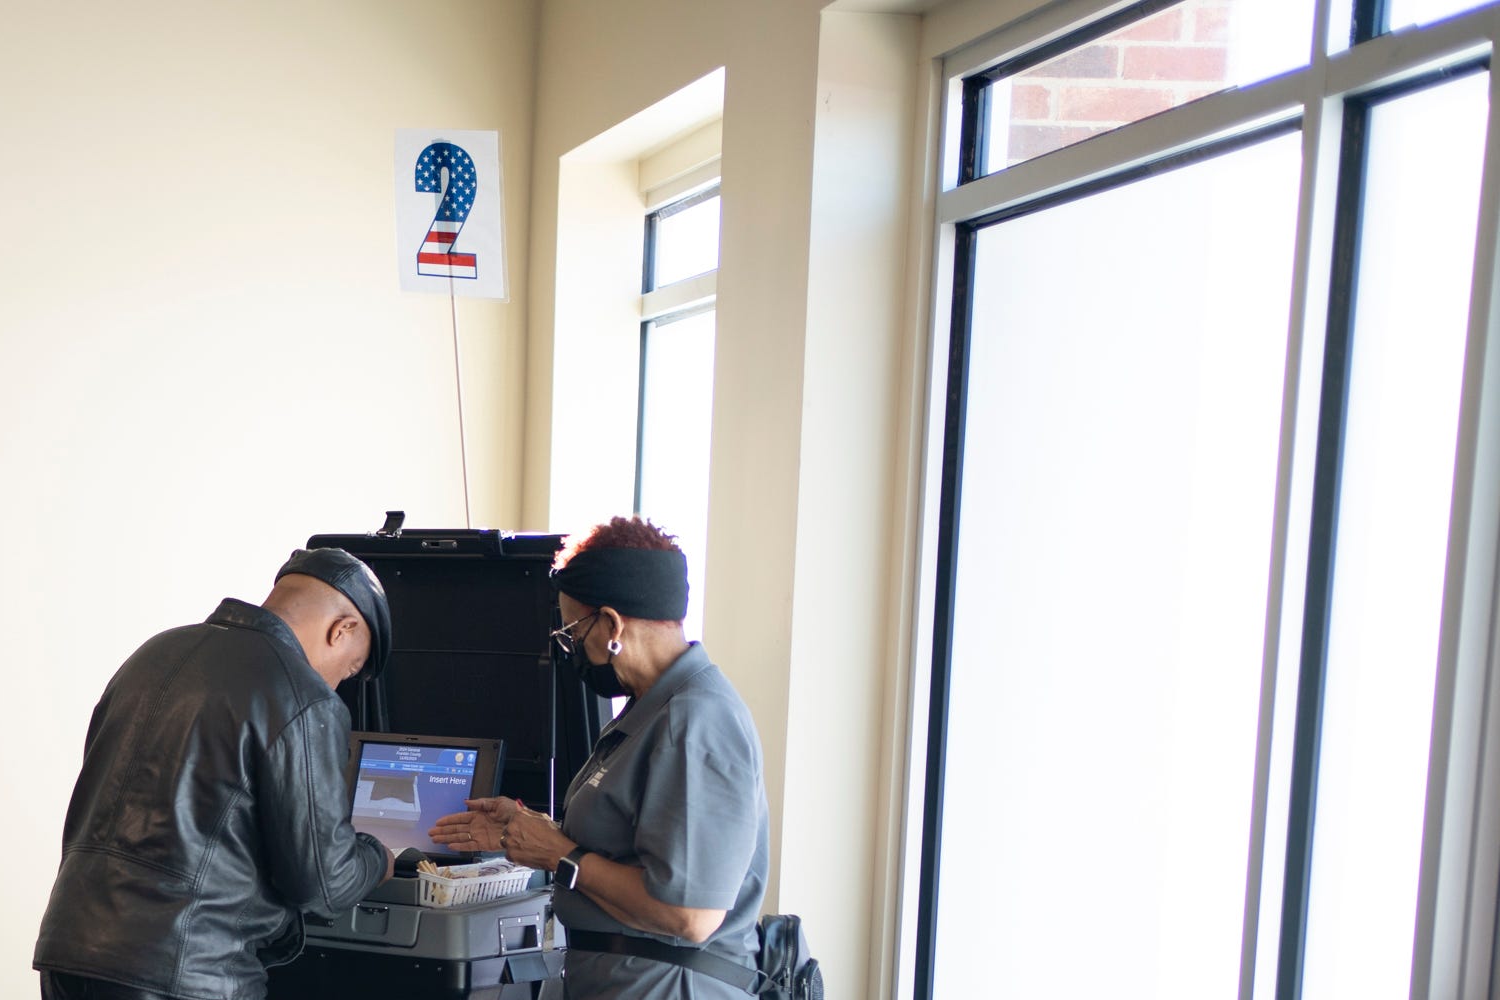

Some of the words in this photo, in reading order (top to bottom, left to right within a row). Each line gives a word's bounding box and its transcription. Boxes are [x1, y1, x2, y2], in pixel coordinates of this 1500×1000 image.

[415, 142, 477, 280] 2
[429, 775, 449, 784] Insert
[450, 776, 467, 785] Here
